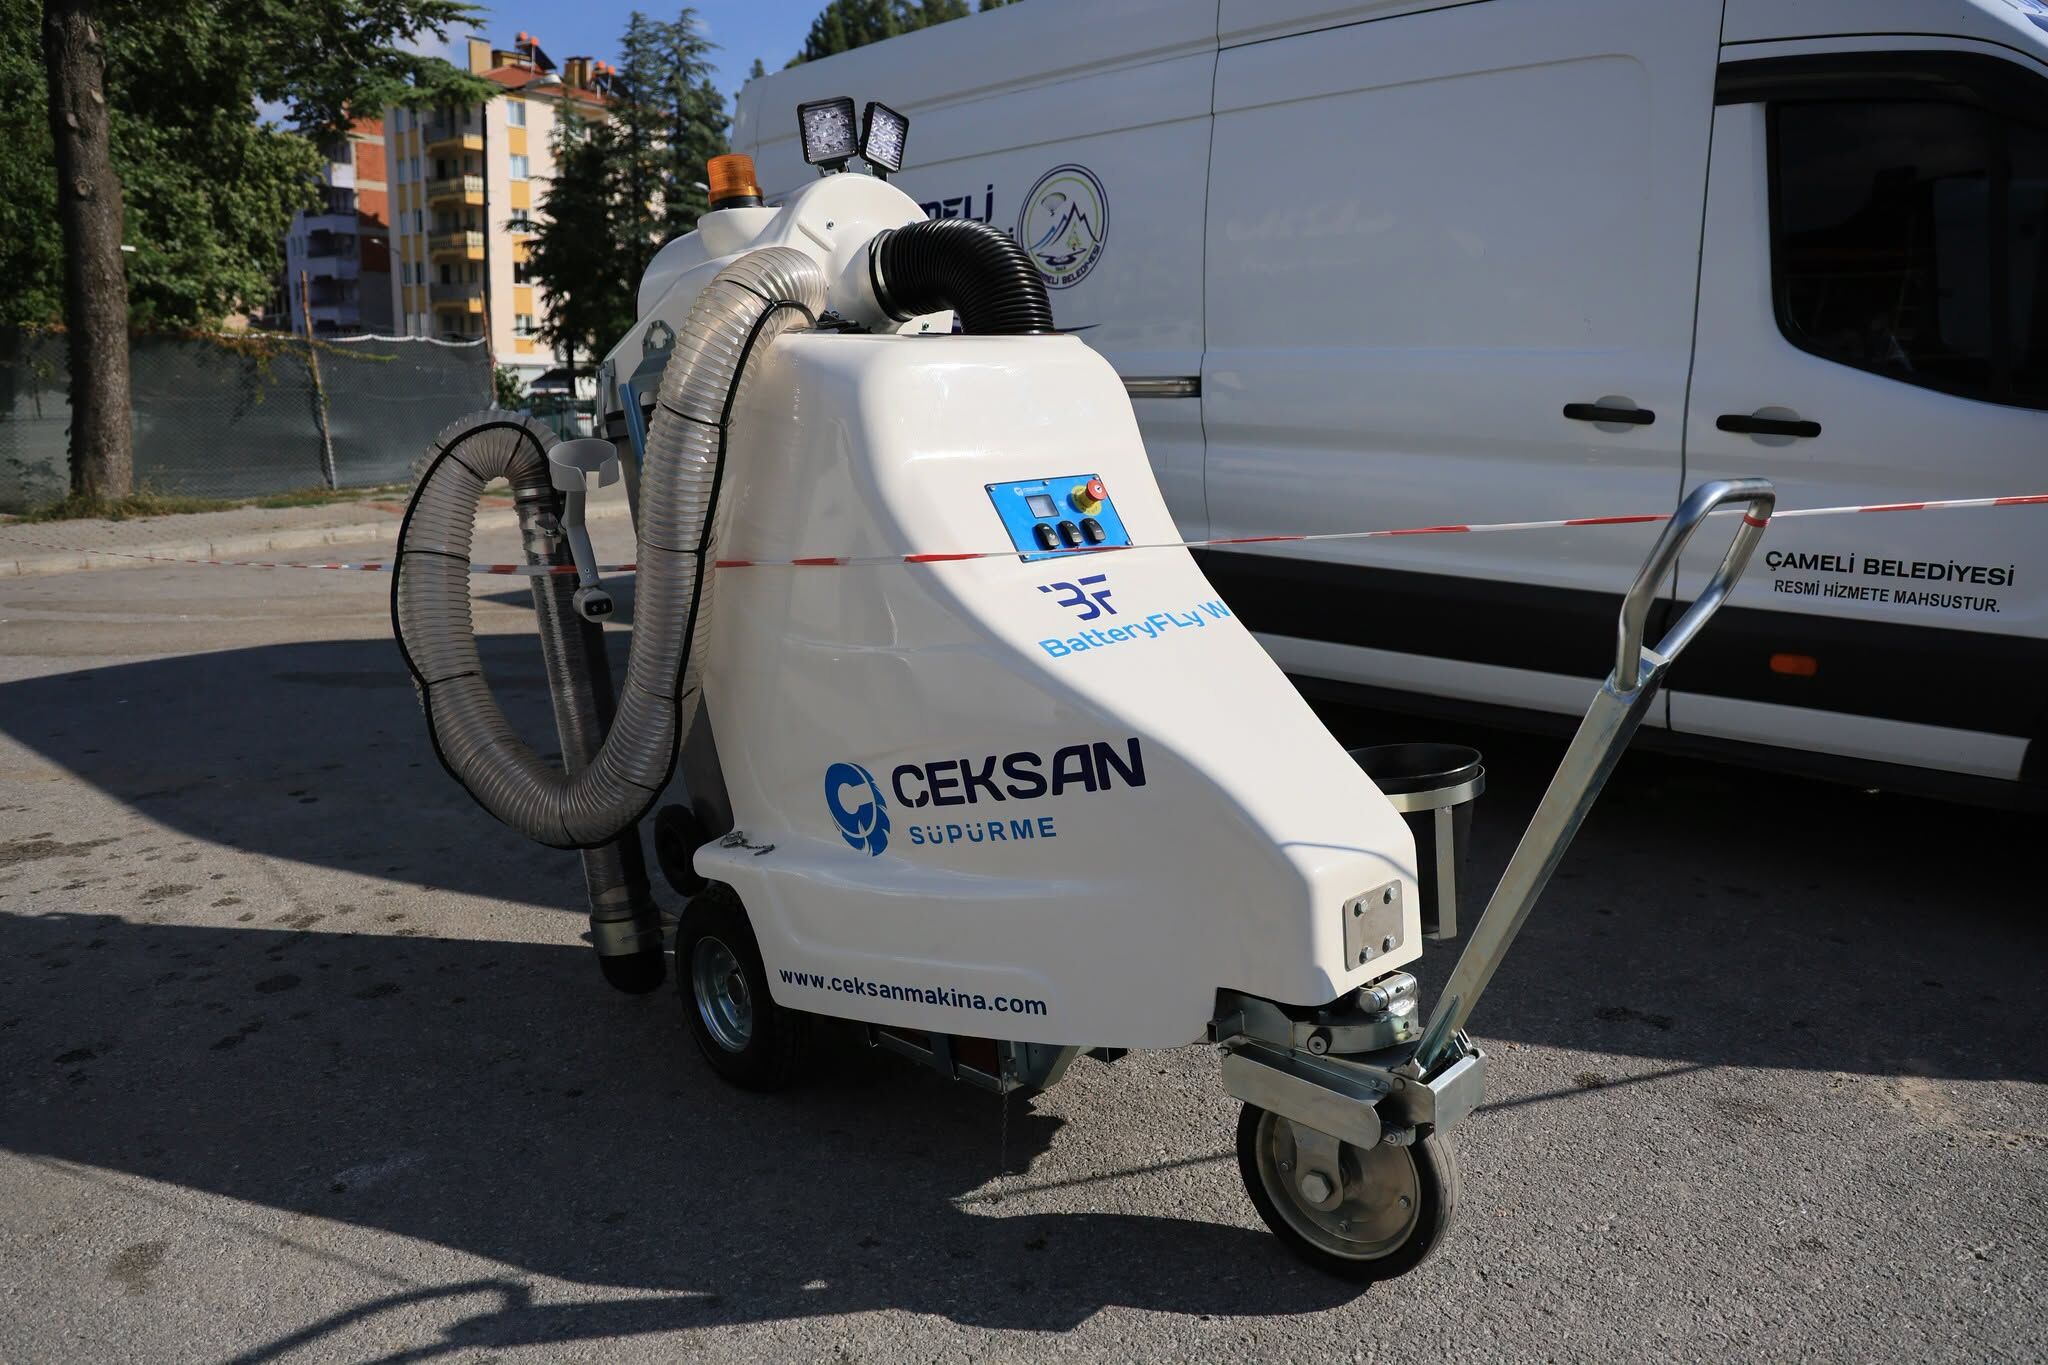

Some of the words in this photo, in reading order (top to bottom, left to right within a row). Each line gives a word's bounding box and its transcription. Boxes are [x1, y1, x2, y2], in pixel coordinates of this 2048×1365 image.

[919, 184, 994, 223] MELİ
[1765, 550, 1855, 574] ÇAMELİ
[1863, 558, 2015, 587] BELEDİYESİ
[1774, 579, 1820, 596] RESMİ
[1823, 581, 1889, 603] HİZMETE
[1893, 590, 2001, 613] MAHSUSTUR.
[908, 817, 1057, 845] SÜPÜRME
[779, 968, 1048, 1016] www.ceksanmakina.com
